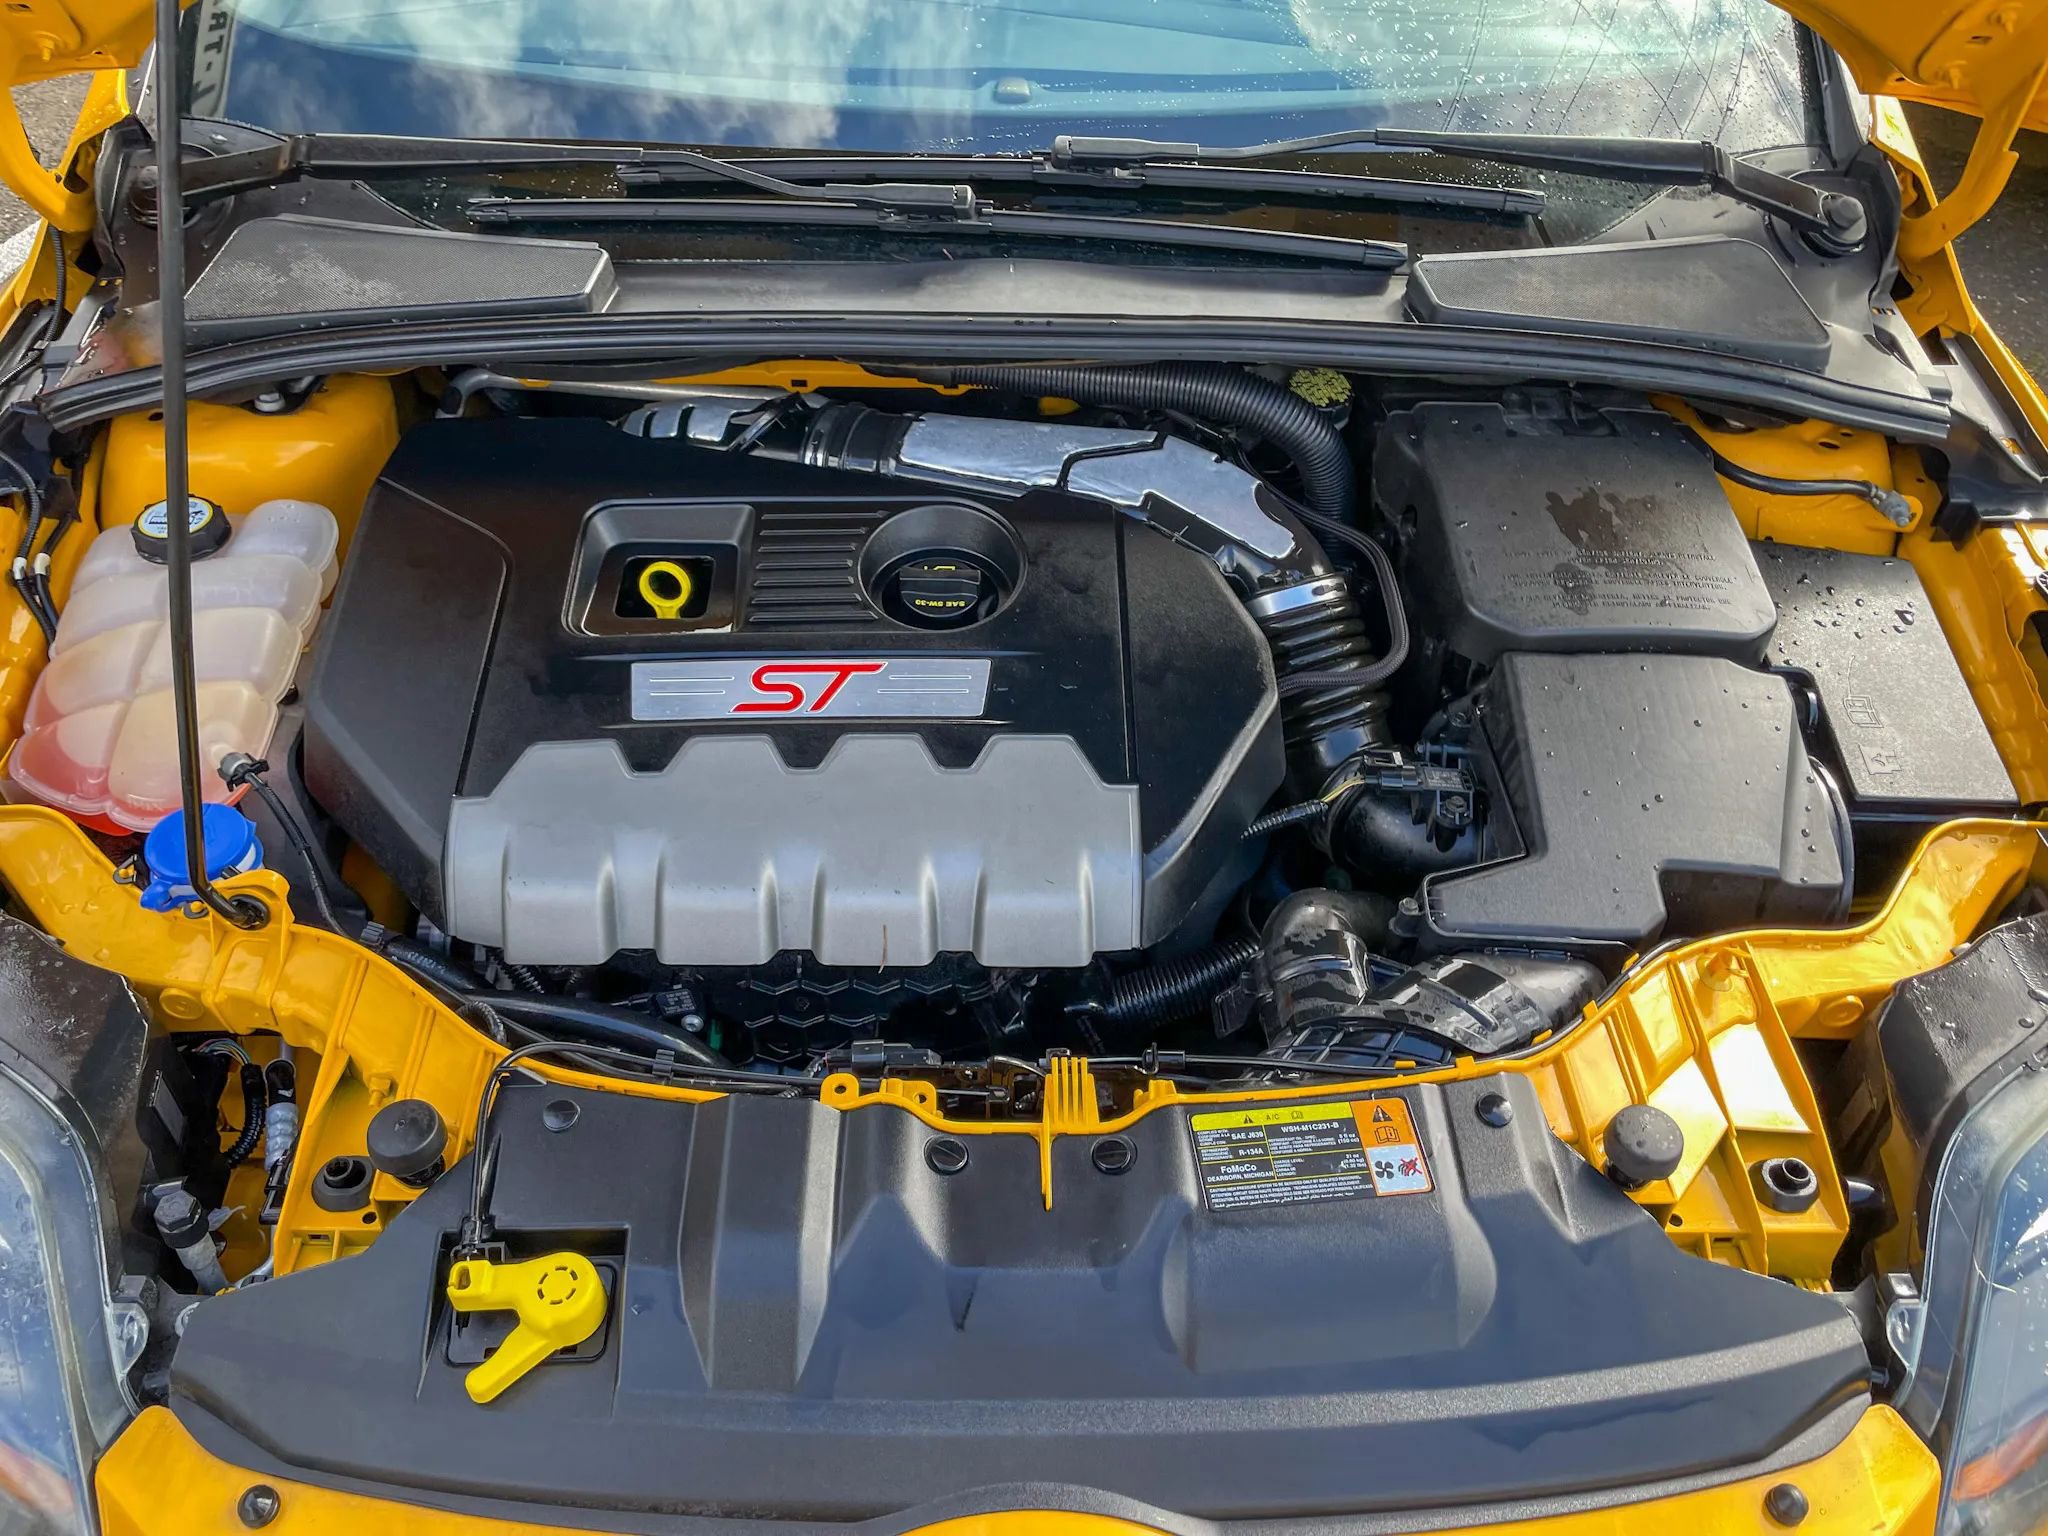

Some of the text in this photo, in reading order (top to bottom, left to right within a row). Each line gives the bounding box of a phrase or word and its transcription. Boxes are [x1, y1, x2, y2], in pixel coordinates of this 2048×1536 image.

[728, 661, 887, 714] ST
[1281, 1123, 1339, 1132] WSH-M1C231-B
[1239, 1148, 1264, 1156] R-134A
[1220, 1164, 1257, 1173] FoMoCo
[1207, 1174, 1244, 1182] DEARBORN,
